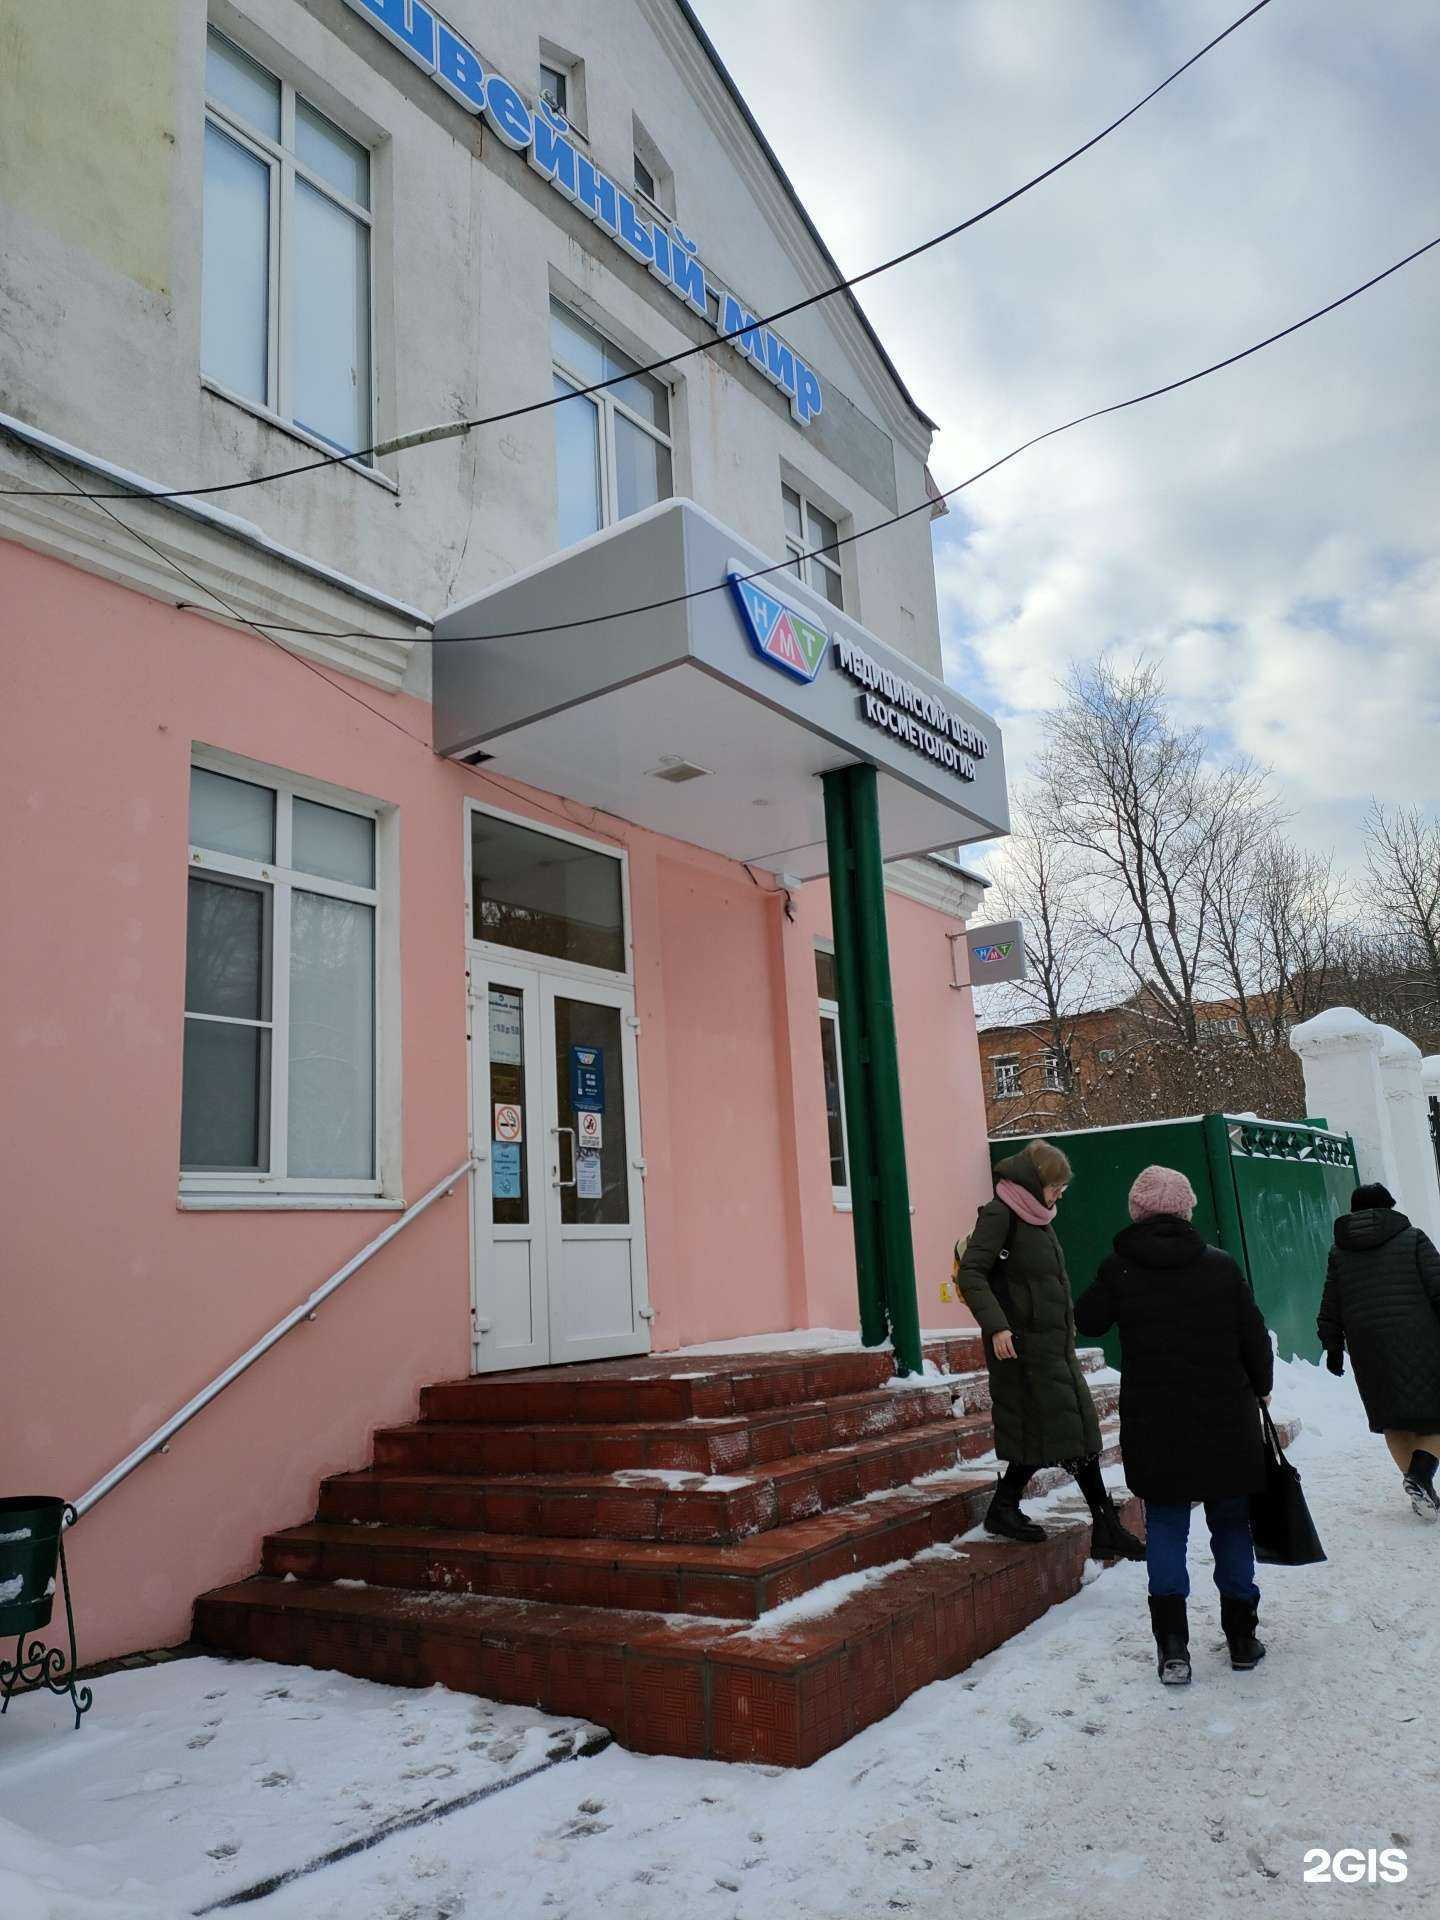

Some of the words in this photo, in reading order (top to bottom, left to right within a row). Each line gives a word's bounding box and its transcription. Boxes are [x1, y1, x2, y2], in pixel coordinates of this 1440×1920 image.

[834, 634, 951, 735] МЕДИЦИНСКИЙ
[950, 712, 990, 758] ЦЕНТР
[863, 691, 977, 781] КОСМЕТОЛОГИЯ
